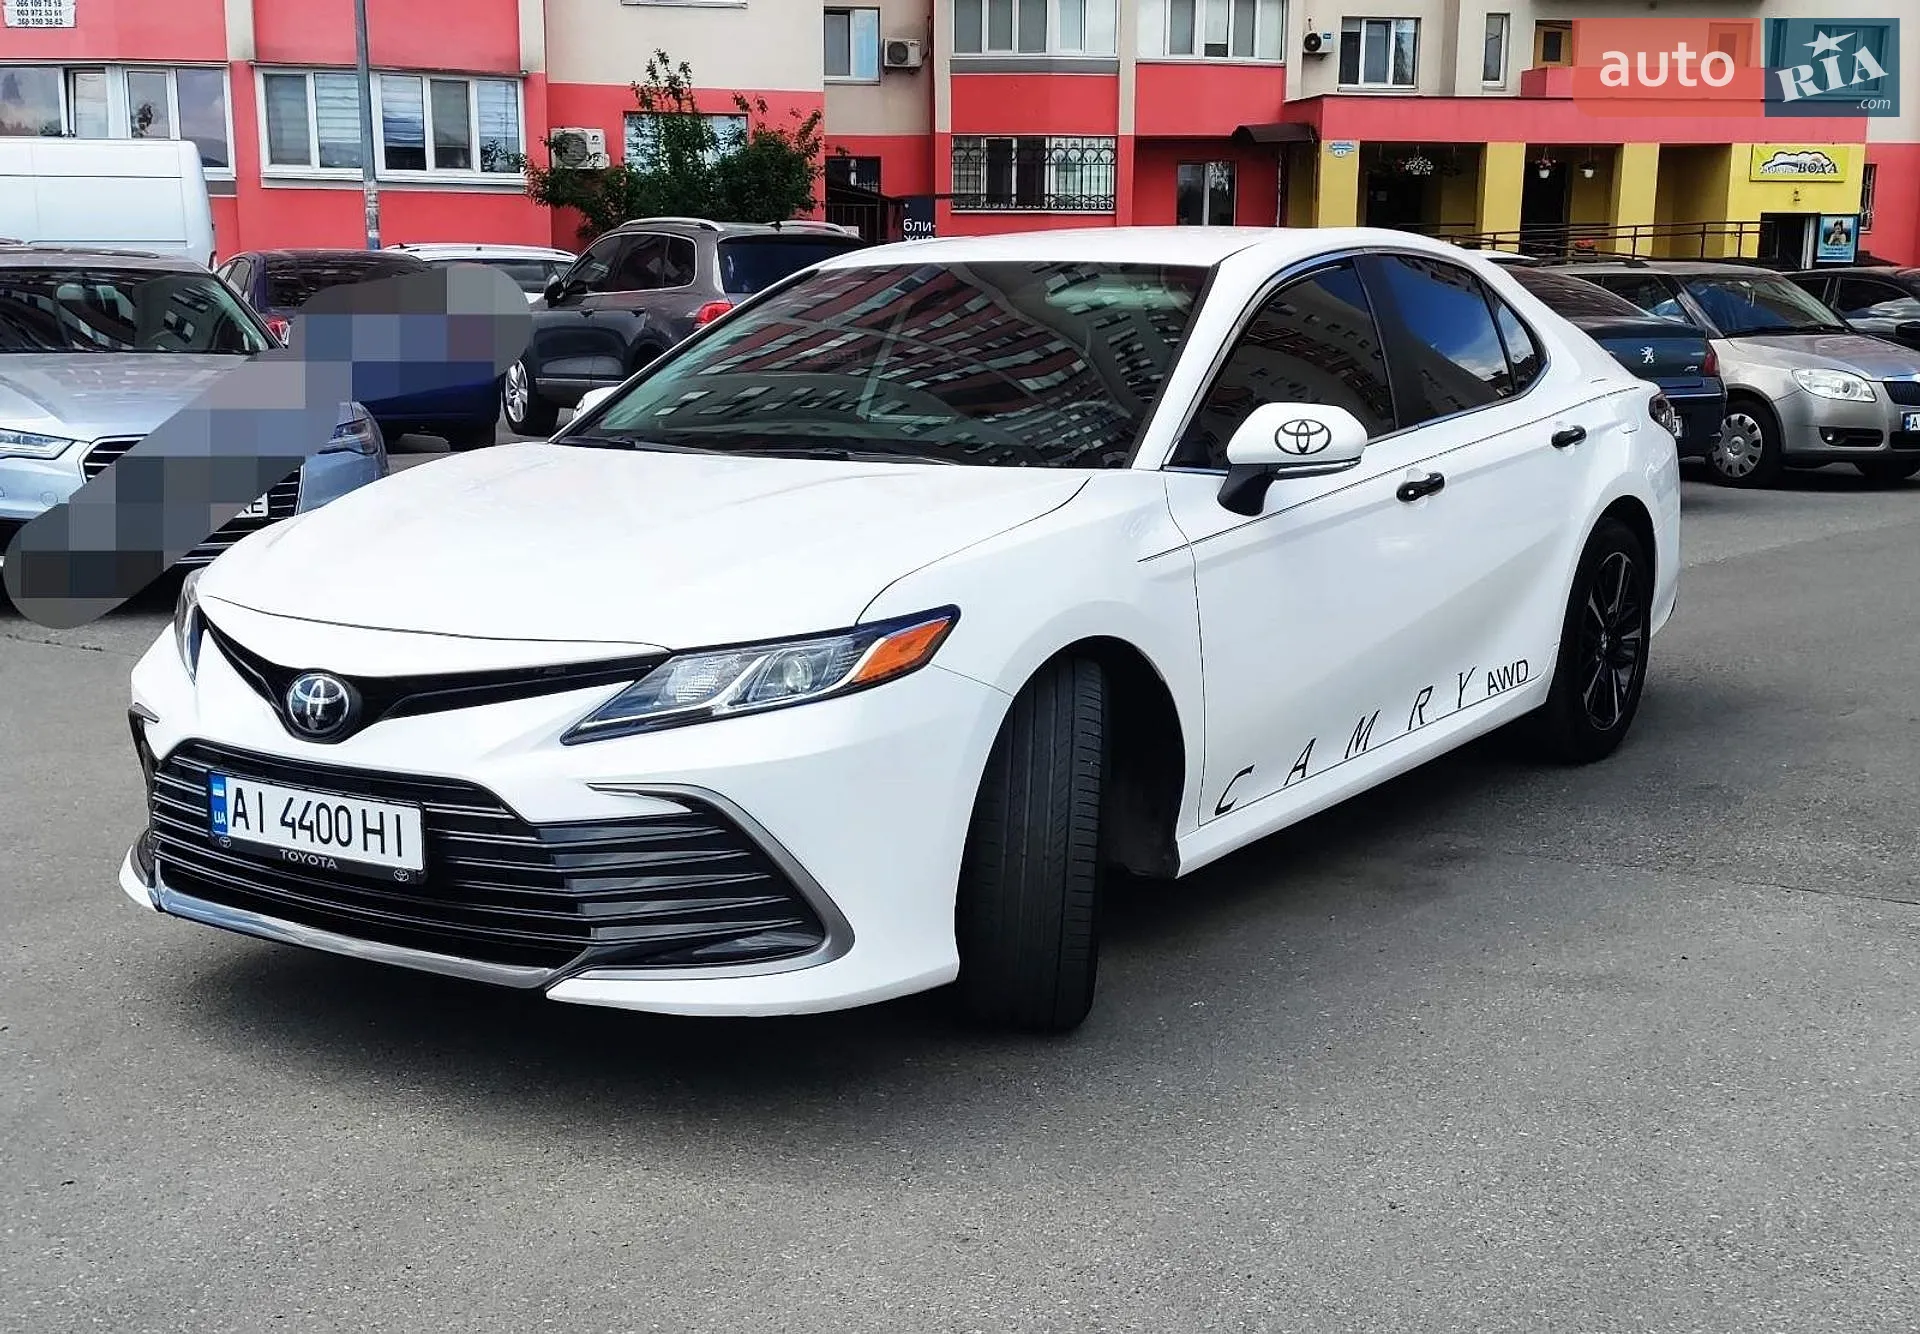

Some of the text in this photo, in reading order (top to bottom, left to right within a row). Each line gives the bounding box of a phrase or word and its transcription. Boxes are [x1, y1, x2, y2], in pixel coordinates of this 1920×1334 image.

[1487, 659, 1529, 696] AWD
[231, 787, 402, 858] AI 4400 HI
[279, 848, 338, 870] TOYOTA
